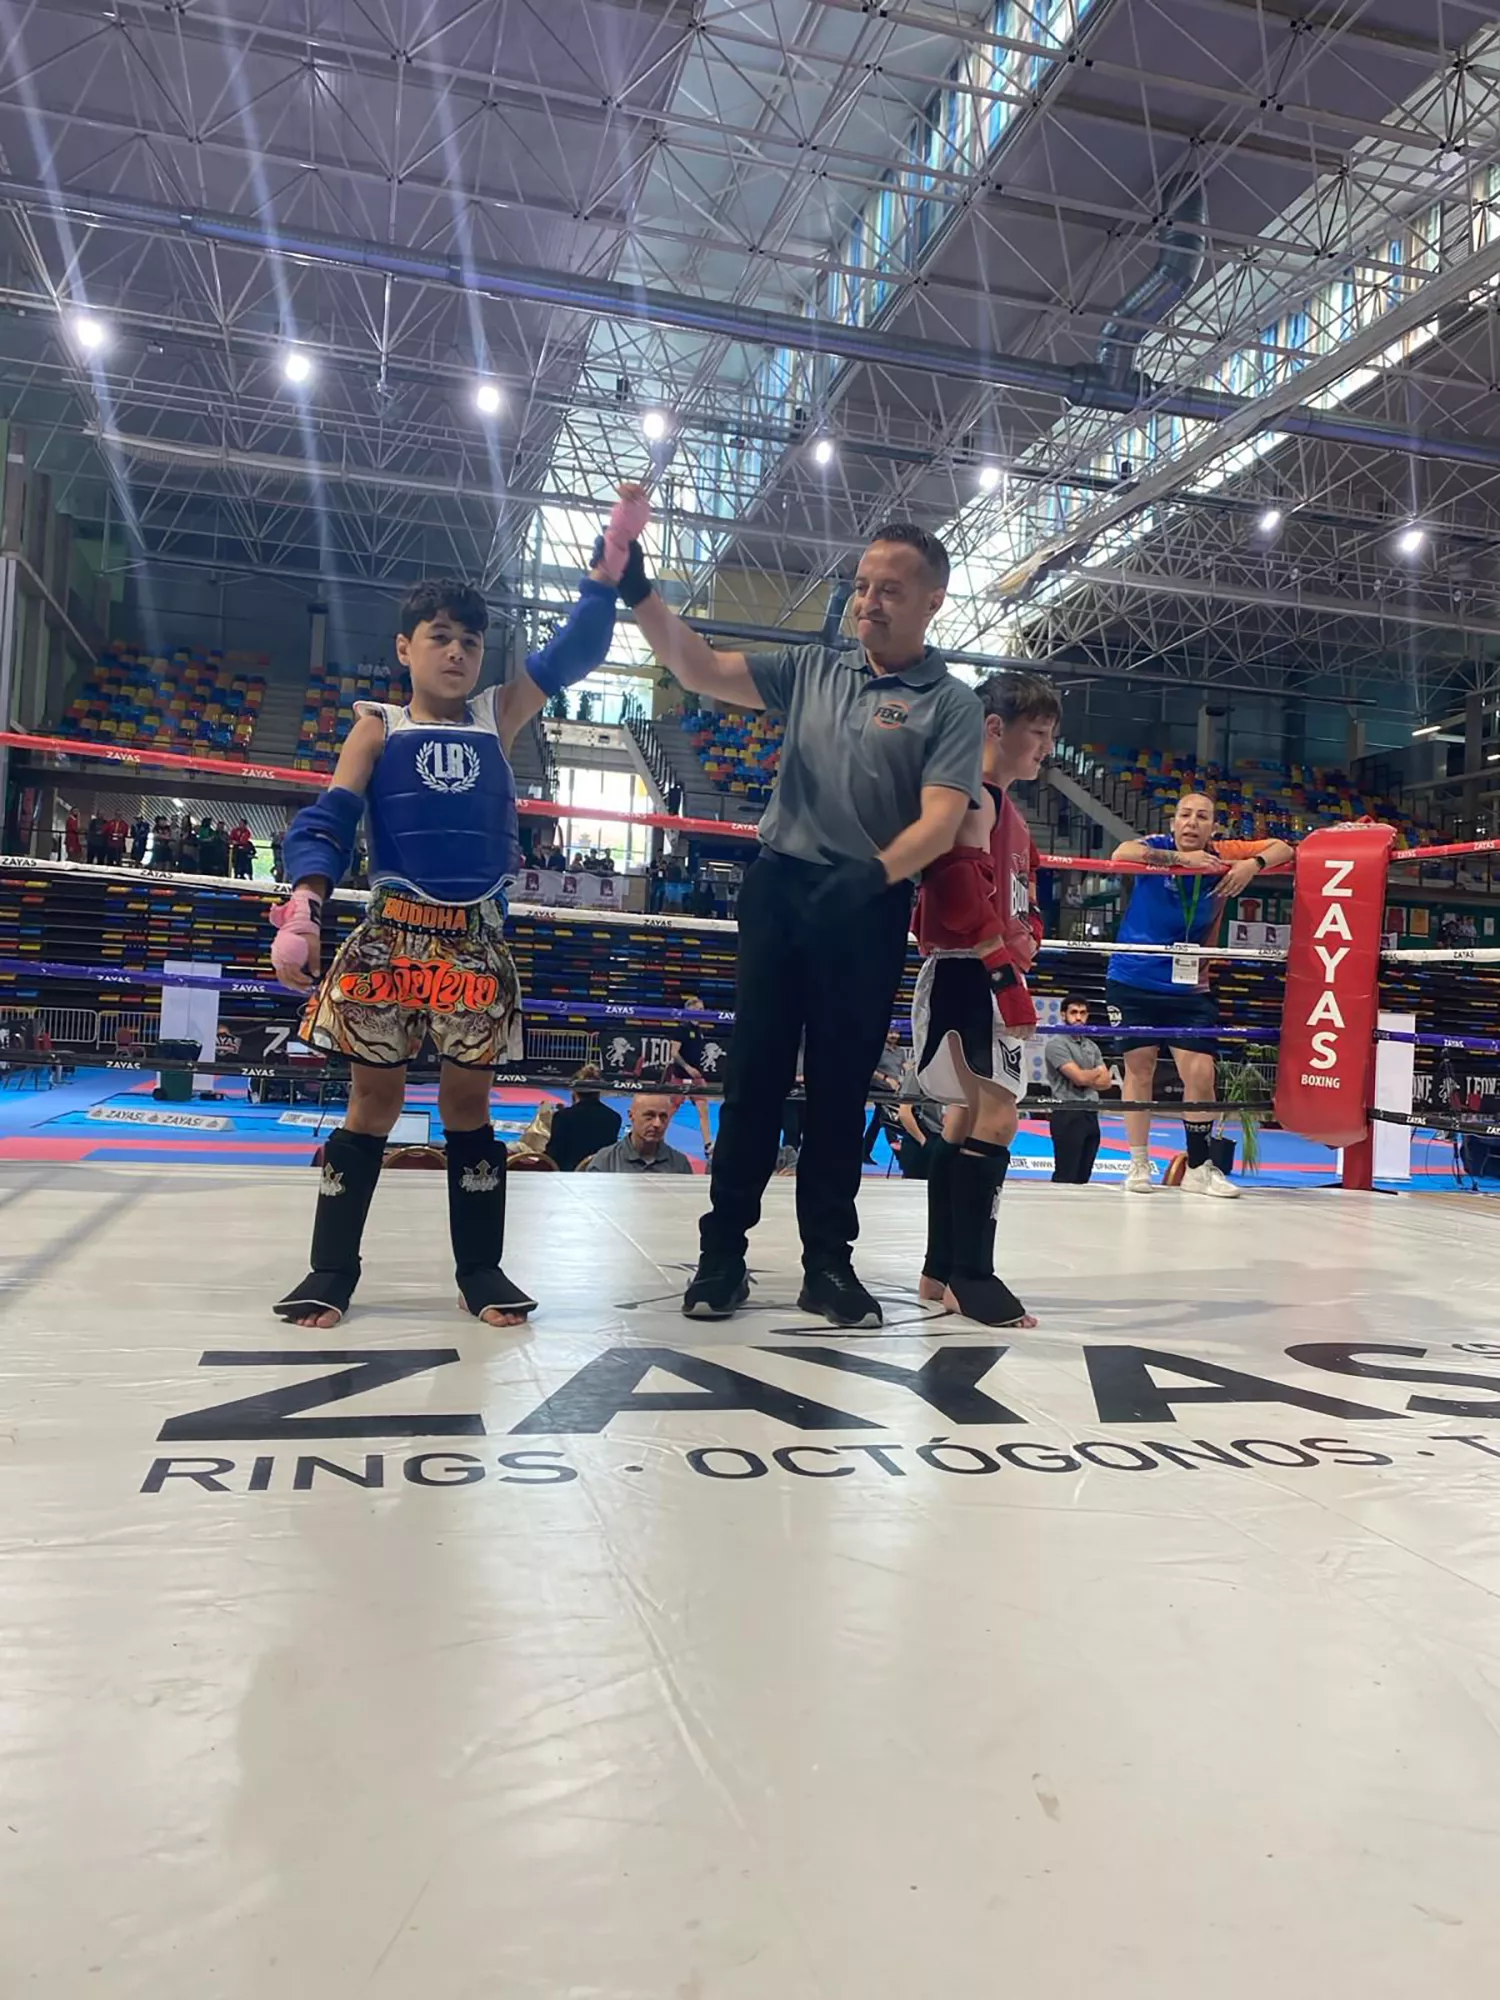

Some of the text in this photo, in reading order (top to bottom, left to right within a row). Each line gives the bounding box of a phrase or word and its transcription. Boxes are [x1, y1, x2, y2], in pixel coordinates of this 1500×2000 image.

[105, 751, 141, 763] ZAYAS
[433, 742, 465, 778] LR
[241, 768, 276, 780] ZAYAS
[1, 857, 37, 868] ZAYAS
[273, 884, 293, 894] ZAY
[381, 896, 468, 931] BUDDHA
[643, 919, 673, 928] ZAYAS
[1305, 859, 1355, 1070] ZAYAS
[231, 984, 266, 993] ZAYAS
[604, 1005, 635, 1015] ZAYAS
[717, 1011, 736, 1020] ZAY
[105, 1060, 141, 1070] ZAYAS
[241, 1067, 276, 1077] ZAYAS
[496, 1074, 528, 1083] ZAYAS
[1300, 1074, 1341, 1090] BOXING
[613, 1081, 643, 1090] ZAYAS
[155, 1342, 1500, 1442] ZAYAS
[139, 1435, 1500, 1494] RINGS OCTÓGONOS T
